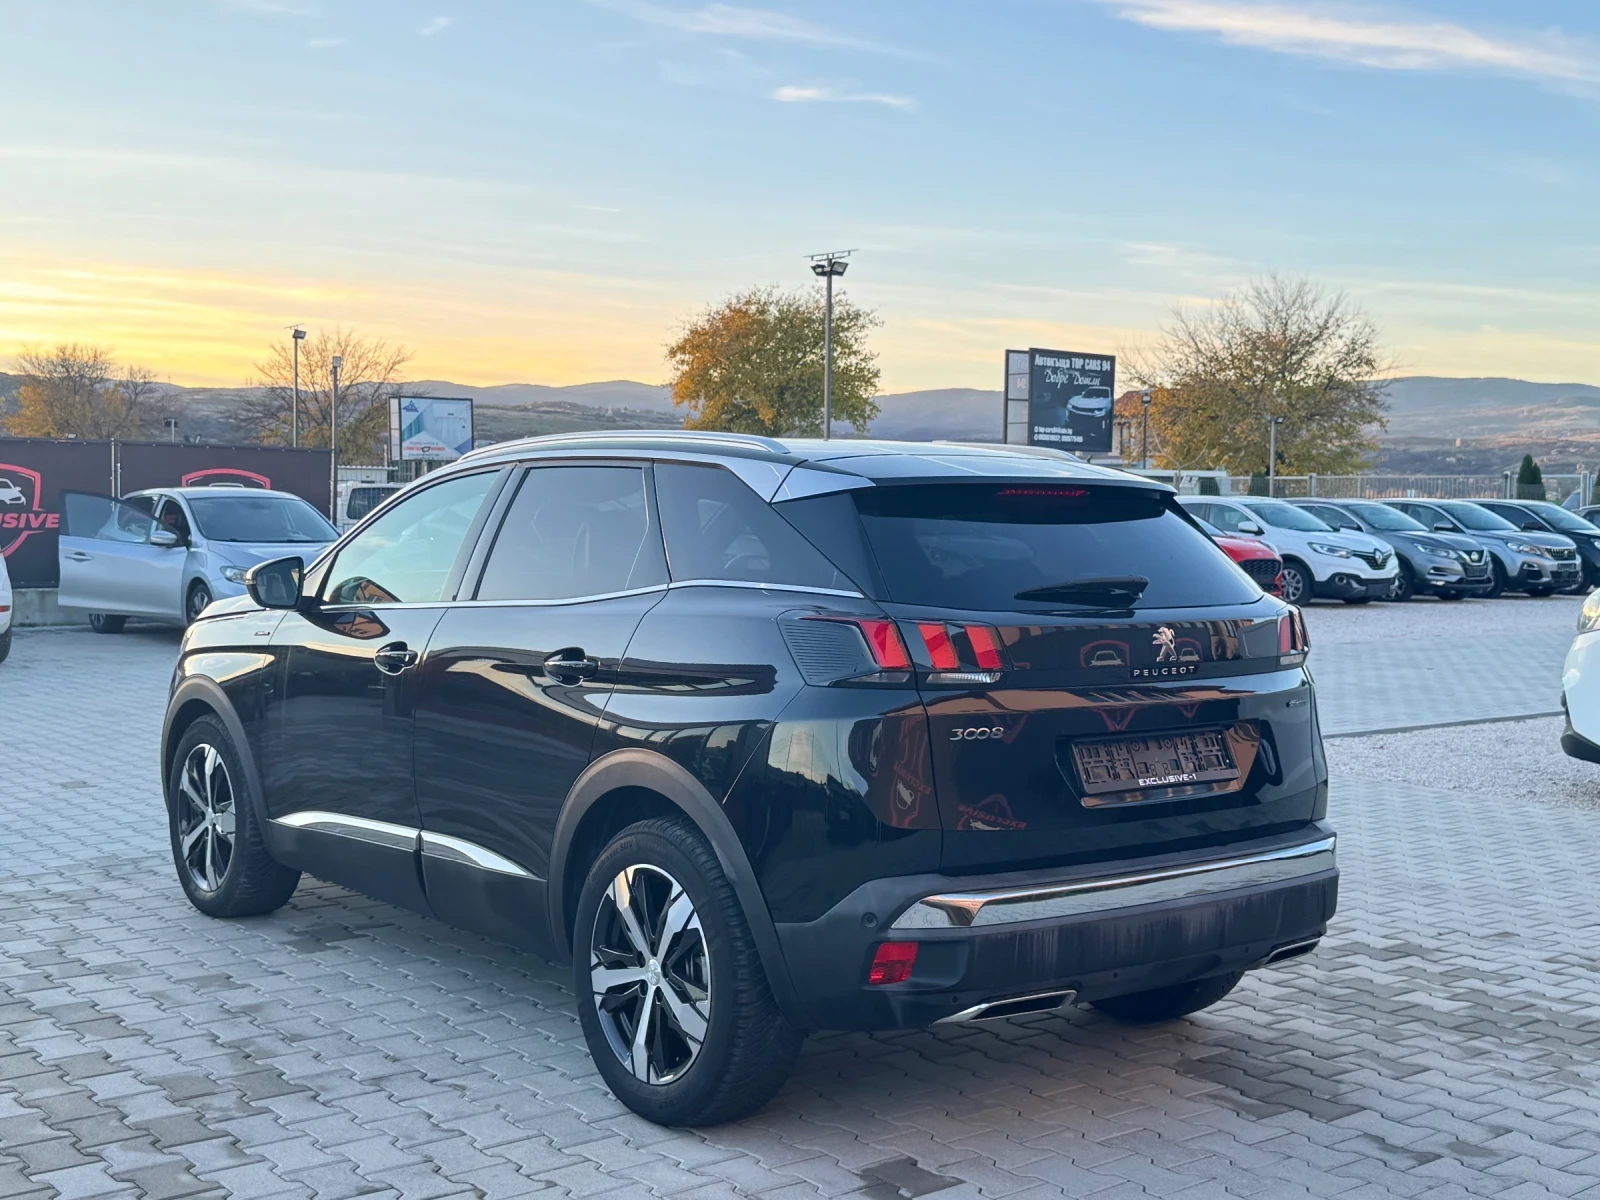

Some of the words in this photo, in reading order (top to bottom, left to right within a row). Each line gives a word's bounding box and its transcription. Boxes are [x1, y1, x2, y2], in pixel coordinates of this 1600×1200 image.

[1034, 354, 1071, 369] Автокъща
[1071, 358, 1084, 369] TOP
[1085, 359, 1102, 371] CARS
[1102, 360, 1111, 372] 94
[0, 513, 60, 528] SIVE
[1133, 666, 1195, 677] PEUGEOT
[949, 726, 1004, 741] 3008
[1138, 773, 1197, 786] EXCLUSIVE-1
